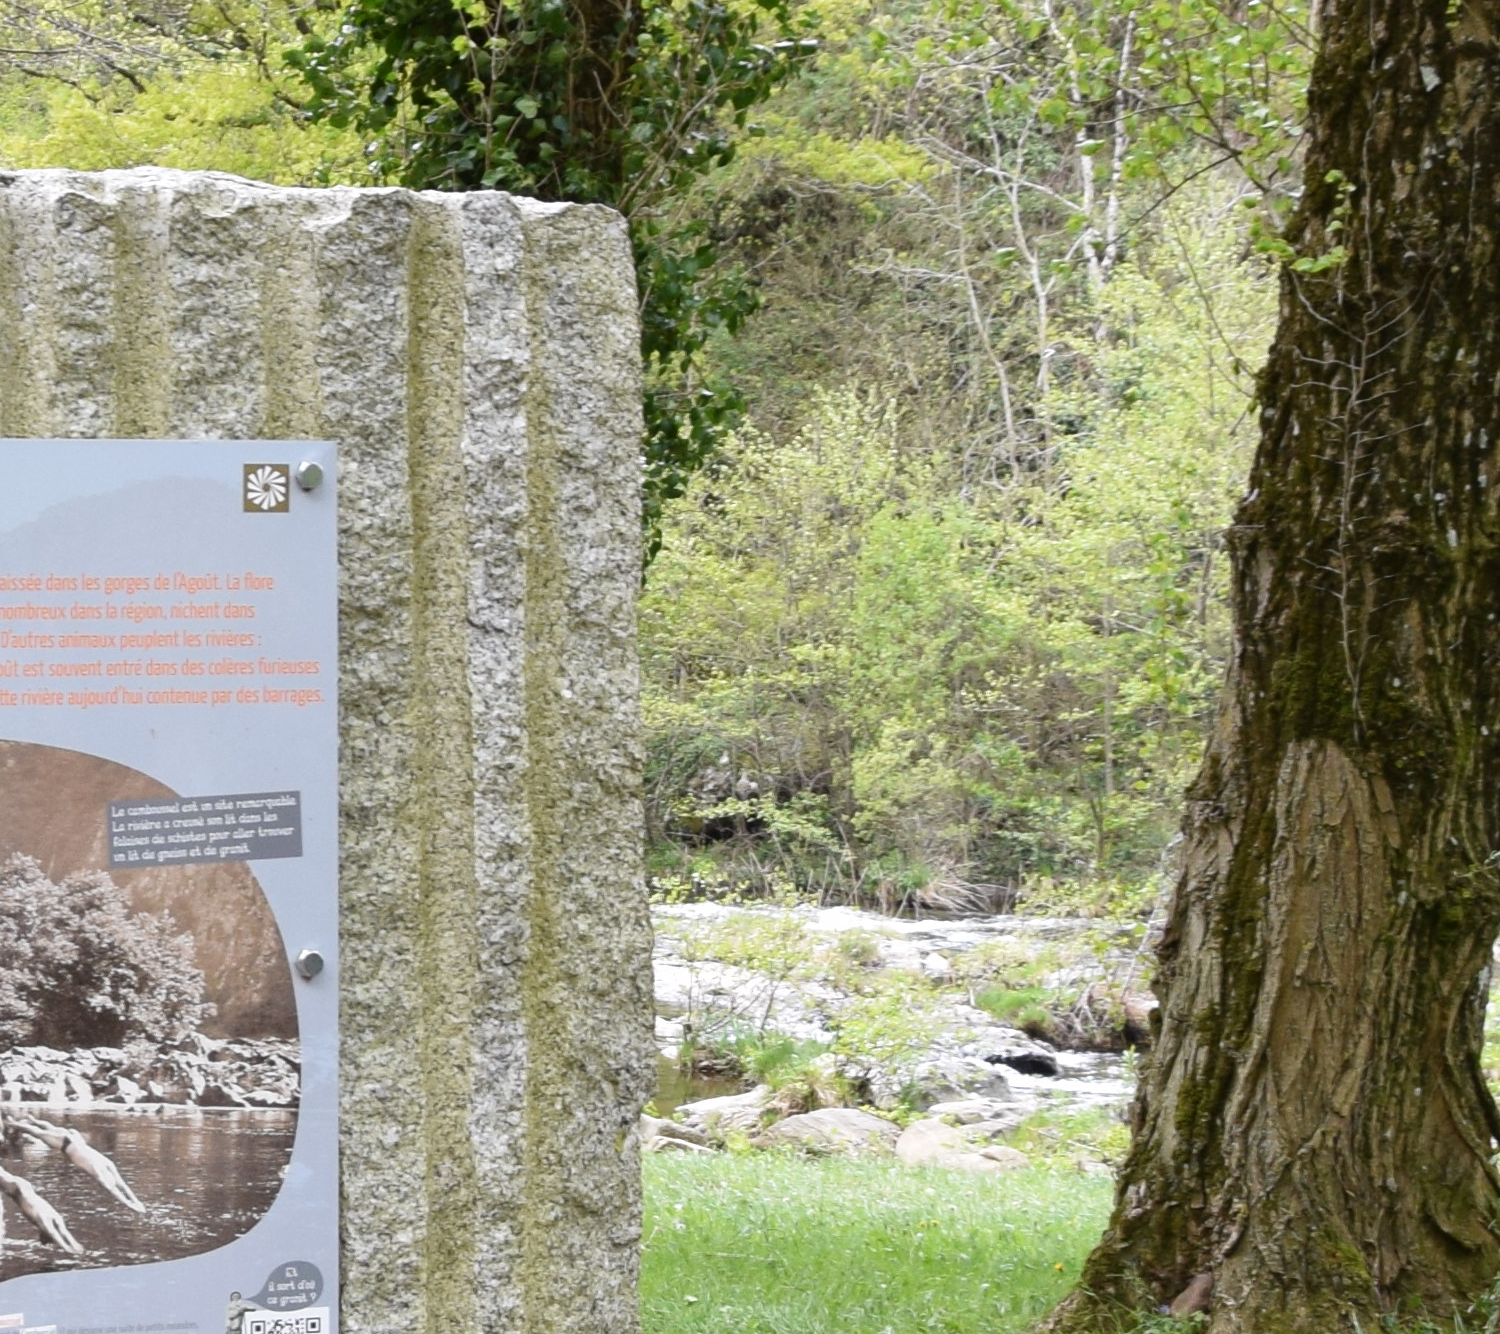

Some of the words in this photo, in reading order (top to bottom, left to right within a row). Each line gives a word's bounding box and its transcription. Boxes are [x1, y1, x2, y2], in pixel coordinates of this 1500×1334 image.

[45, 574, 78, 592] dans
[80, 573, 101, 592] les
[103, 578, 150, 595] gorges
[152, 573, 169, 591] de
[172, 573, 220, 595] l'Agoût.
[223, 573, 241, 591] La
[243, 573, 275, 591] flore
[69, 601, 102, 619] dans
[104, 601, 118, 619] la
[121, 602, 165, 623] région,
[169, 601, 220, 619] nichent
[222, 601, 256, 619] dans
[57, 631, 117, 648] animaux
[118, 629, 179, 652] peuplent
[182, 629, 201, 647] les
[205, 631, 256, 647] rivières
